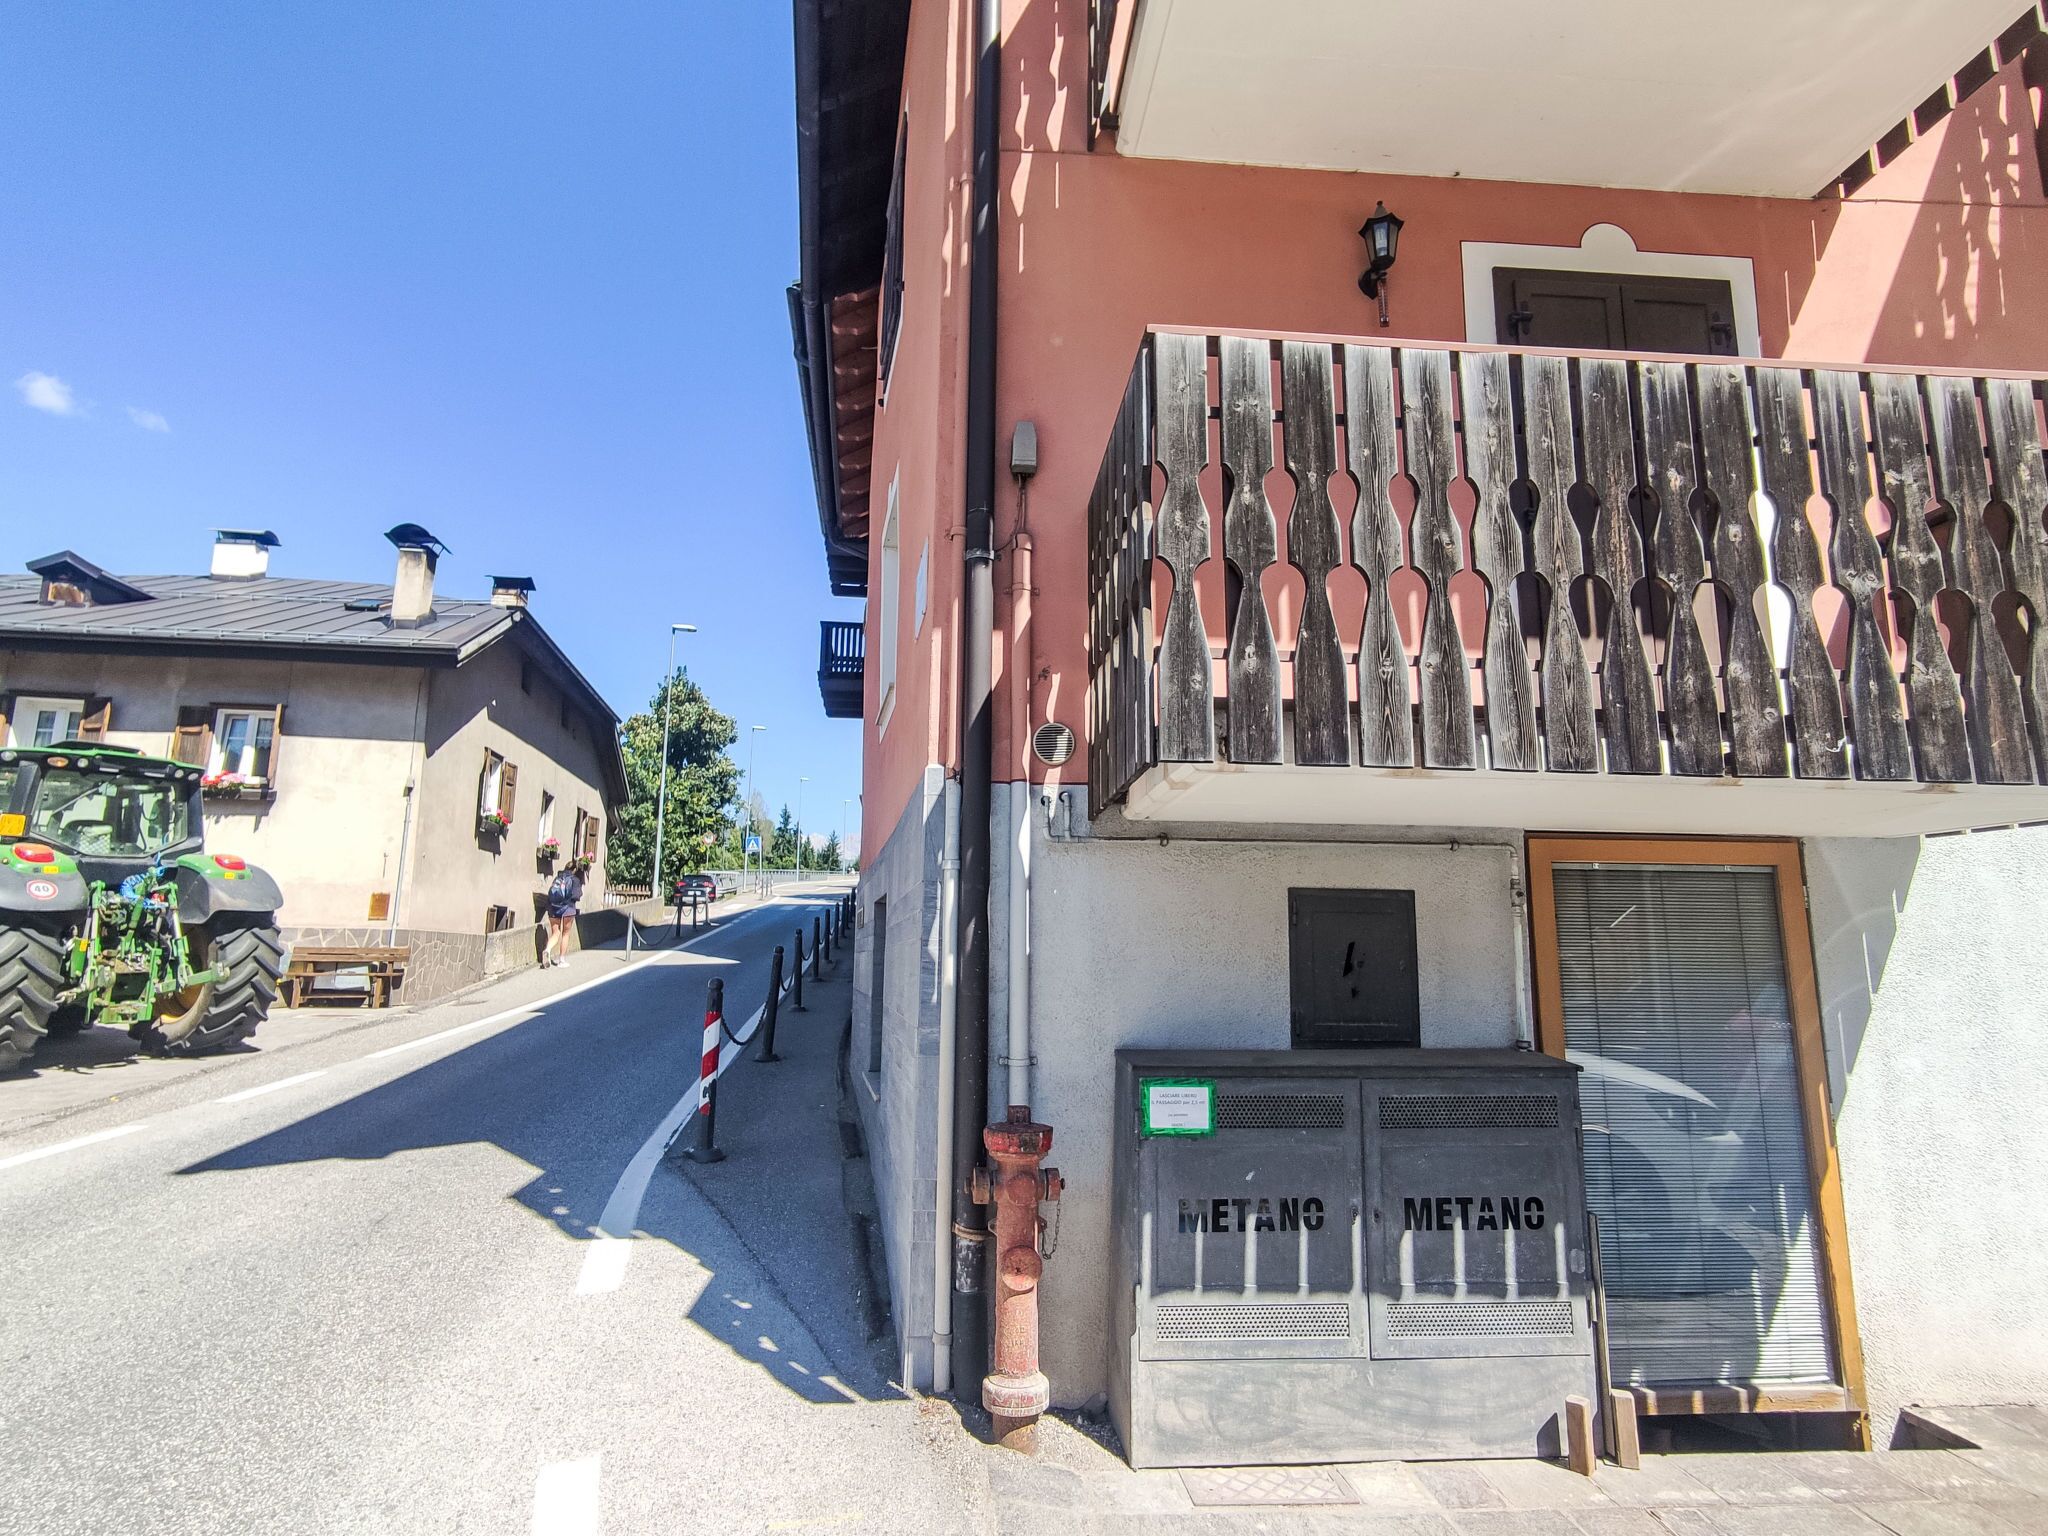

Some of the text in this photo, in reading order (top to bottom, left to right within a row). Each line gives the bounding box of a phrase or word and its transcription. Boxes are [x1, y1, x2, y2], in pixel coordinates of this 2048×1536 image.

[34, 885, 50, 893] 40
[1178, 1197, 1325, 1233] METANO
[1403, 1196, 1545, 1232] METANO
